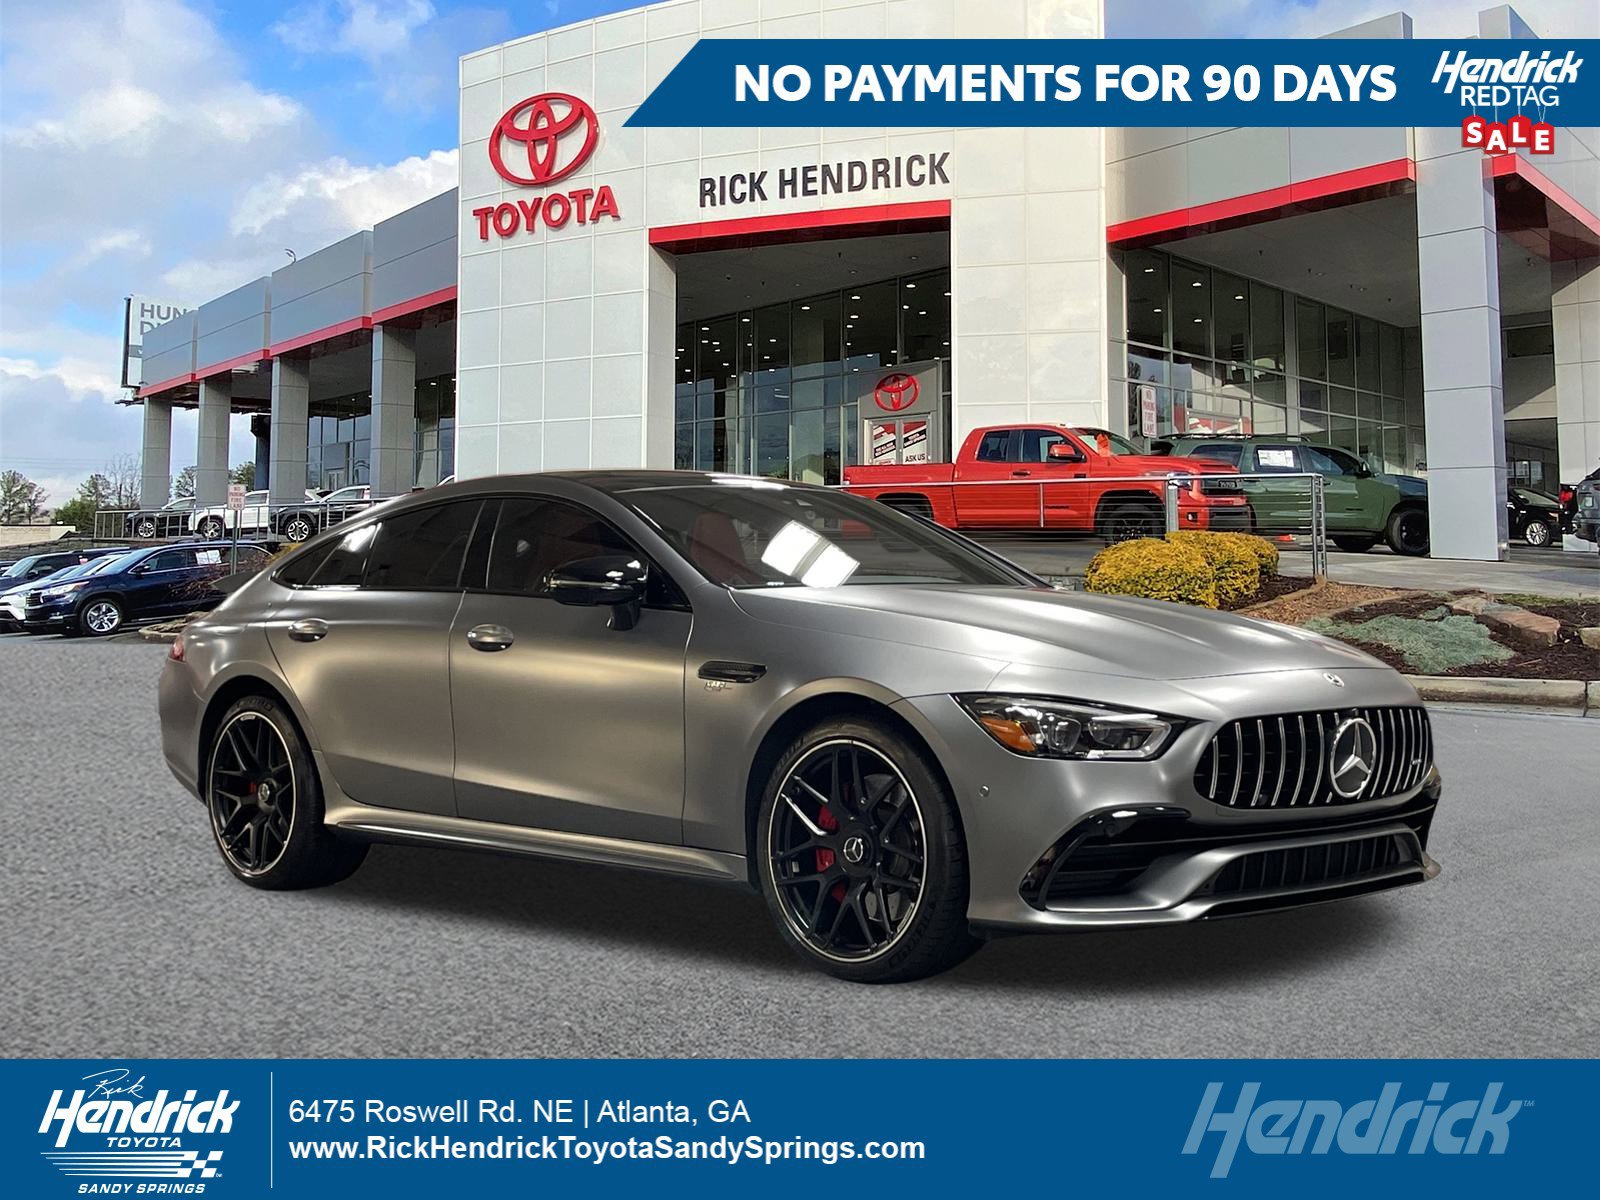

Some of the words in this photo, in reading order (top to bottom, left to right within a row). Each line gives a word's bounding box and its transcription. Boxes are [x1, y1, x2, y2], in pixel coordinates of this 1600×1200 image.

[699, 170, 768, 208] RICK
[779, 151, 951, 199] HENDRICK
[472, 185, 619, 241] TOYOTA
[905, 455, 917, 463] ASK
[917, 453, 926, 461] US
